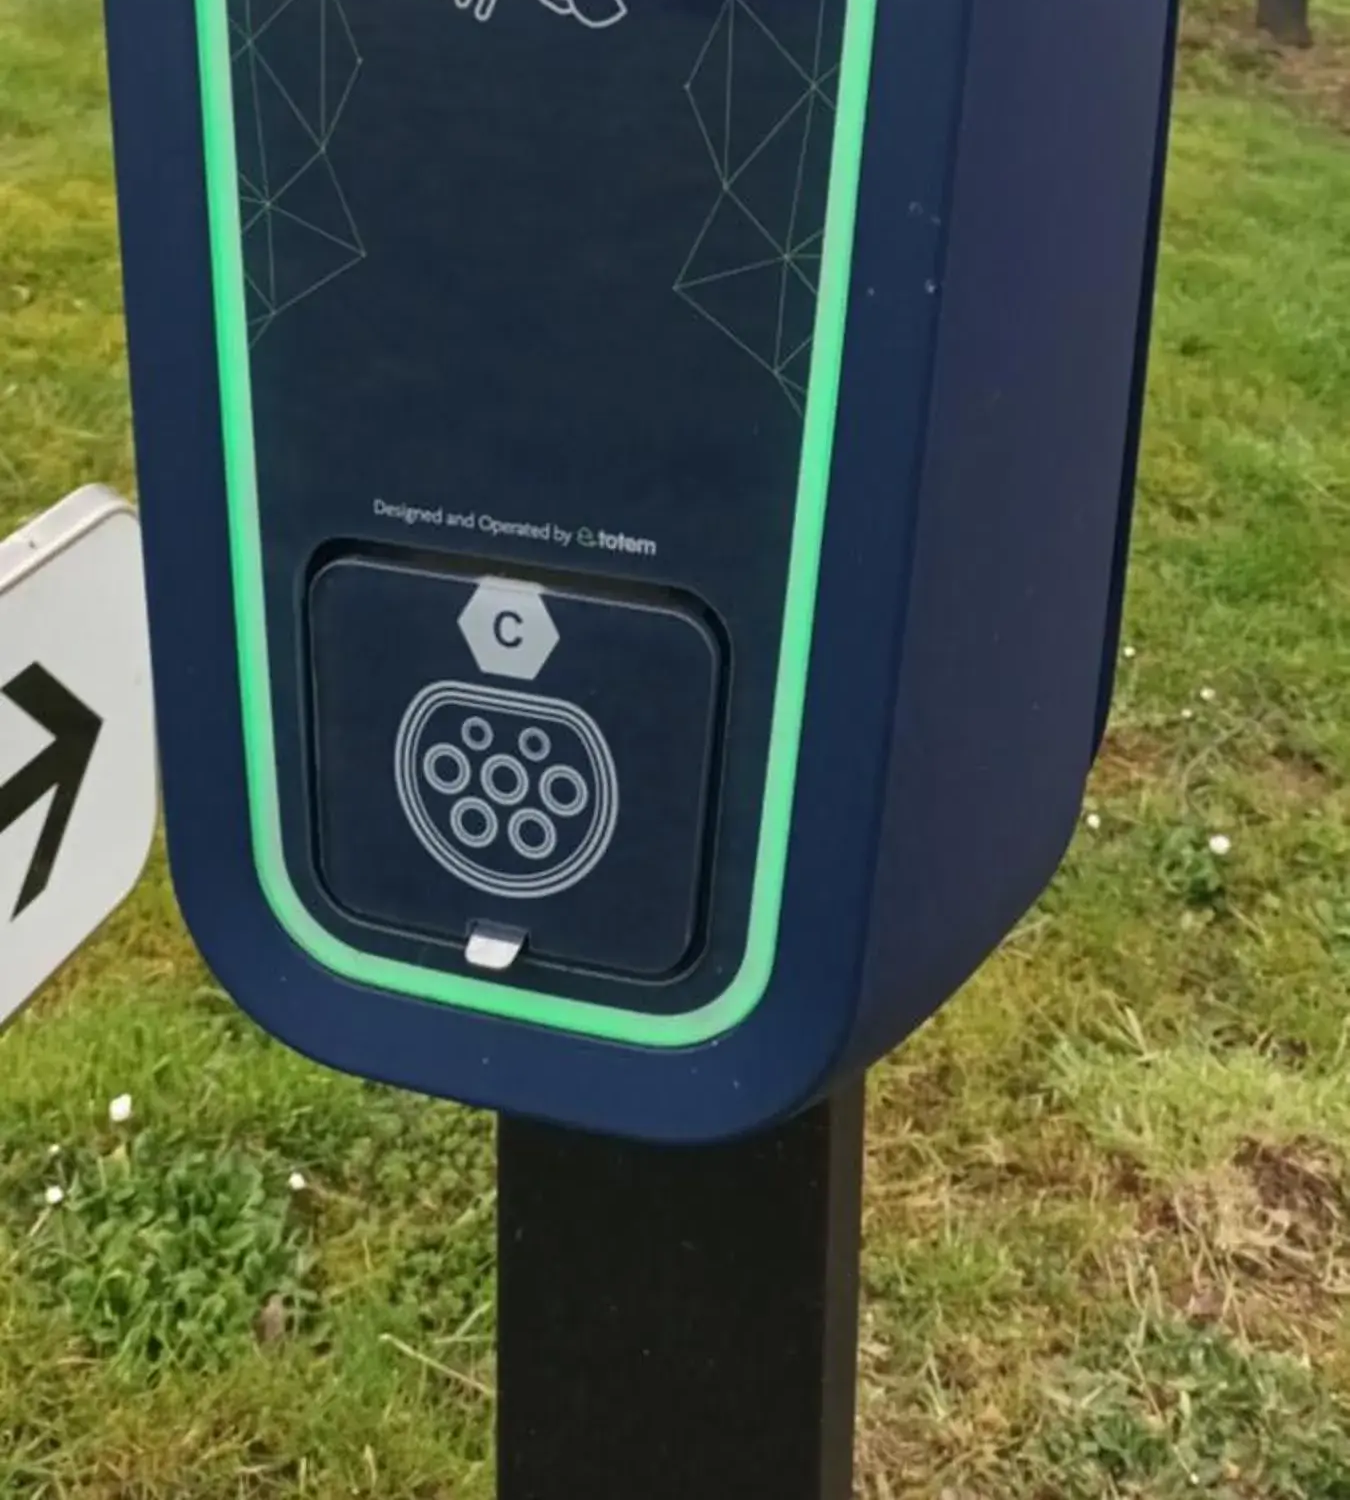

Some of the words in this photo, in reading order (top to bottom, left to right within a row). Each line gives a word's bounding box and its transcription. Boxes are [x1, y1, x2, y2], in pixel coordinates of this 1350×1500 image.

[374, 498, 443, 525] Designed
[446, 510, 475, 529] and
[478, 514, 551, 541] Operated
[553, 523, 572, 548] by
[493, 611, 524, 649] C
